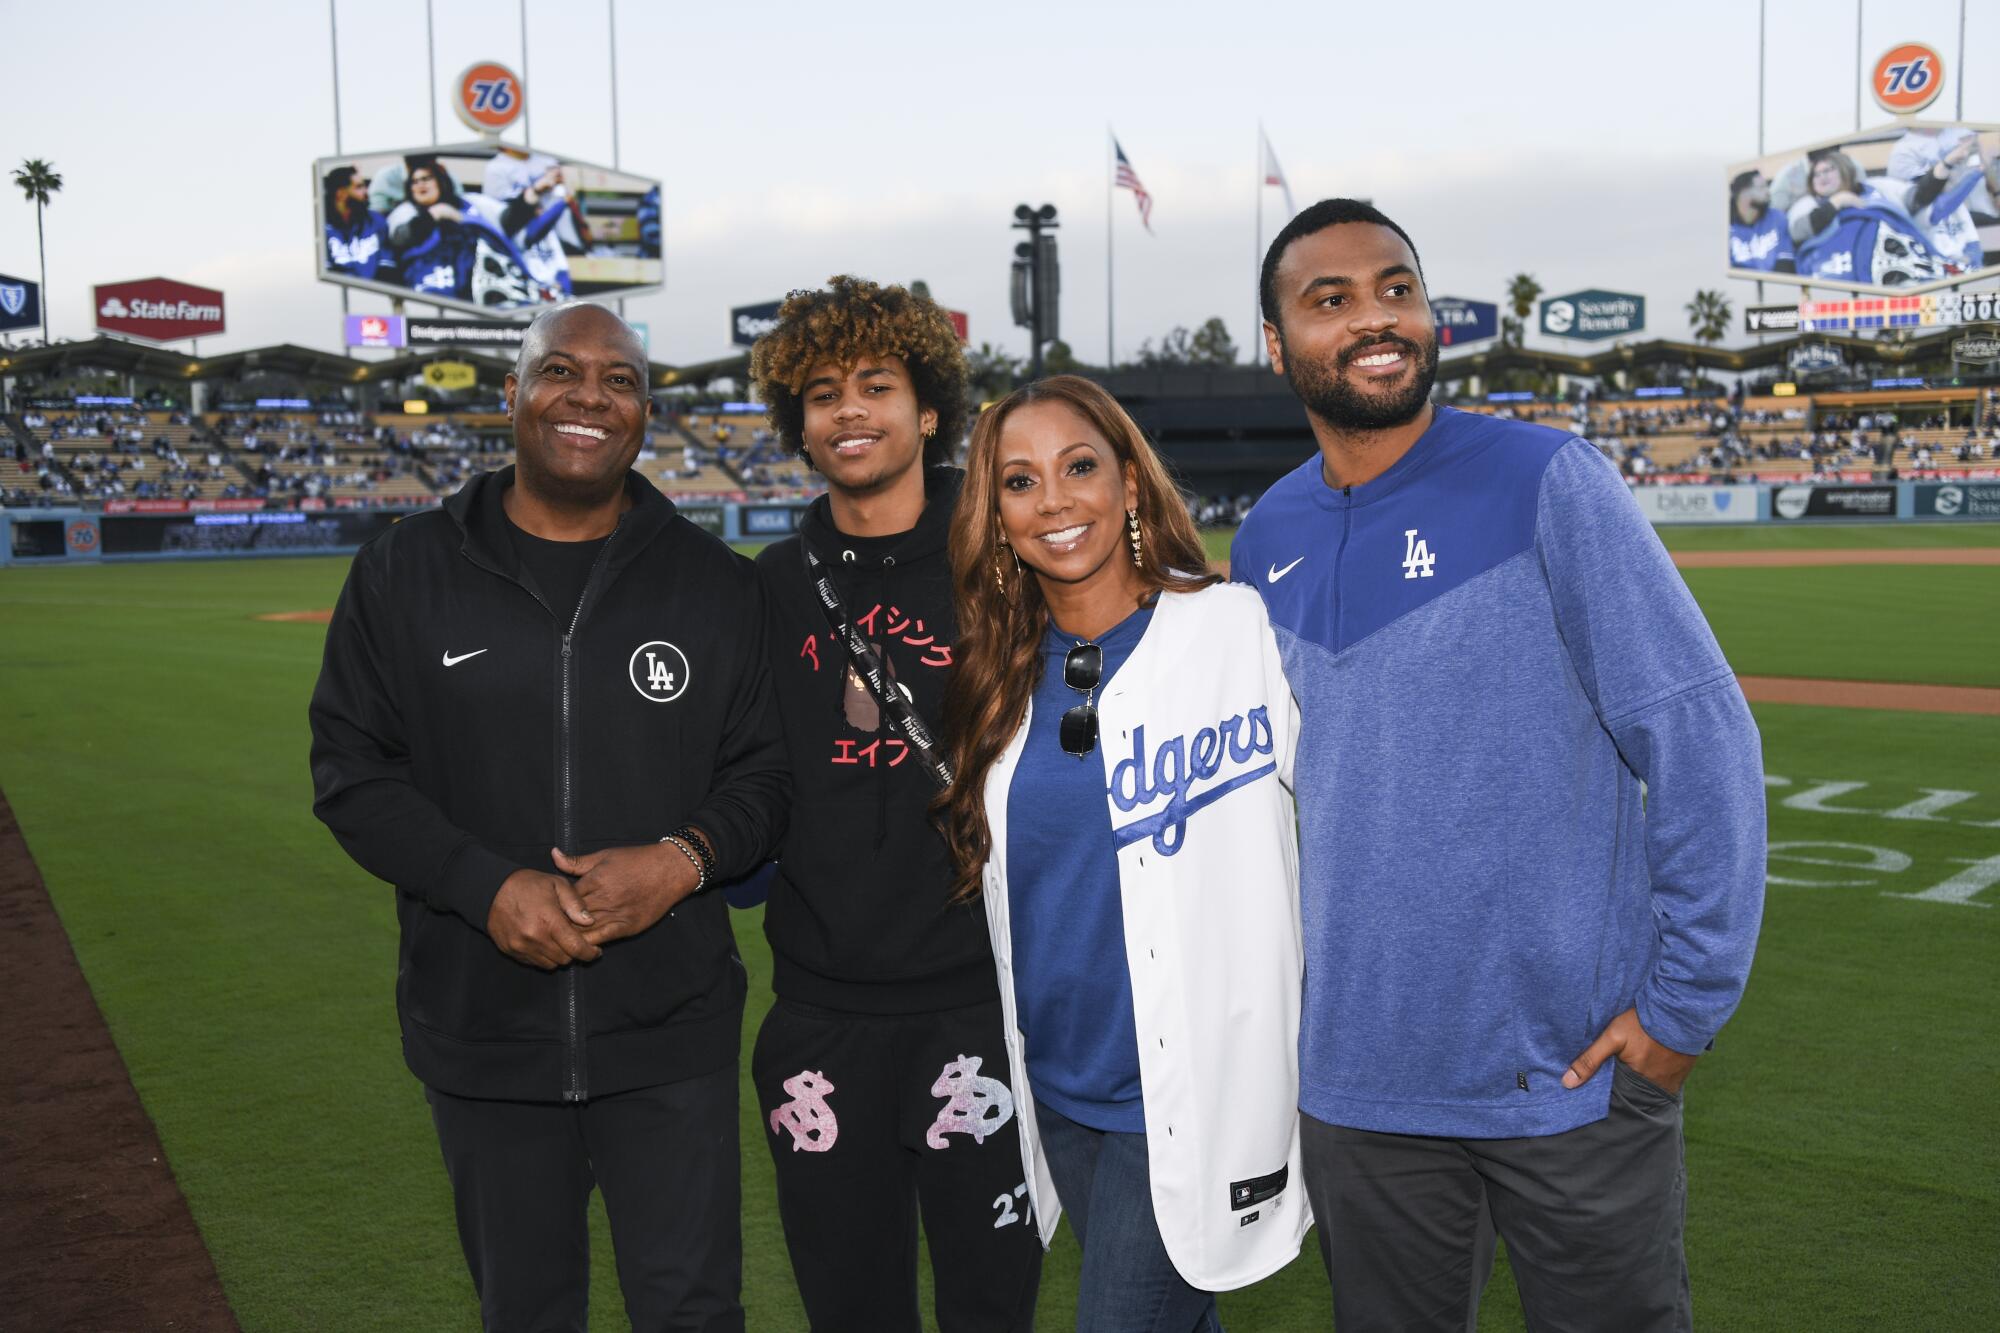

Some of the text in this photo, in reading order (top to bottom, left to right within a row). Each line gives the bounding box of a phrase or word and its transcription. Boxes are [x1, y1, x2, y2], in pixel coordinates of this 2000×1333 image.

[1884, 56, 1931, 95] 76
[471, 79, 513, 113] 76
[1579, 300, 1638, 319] Security
[1579, 316, 1629, 331] Benefit
[73, 528, 93, 544] 76
[1402, 529, 1435, 579] LA
[646, 653, 673, 690] LA
